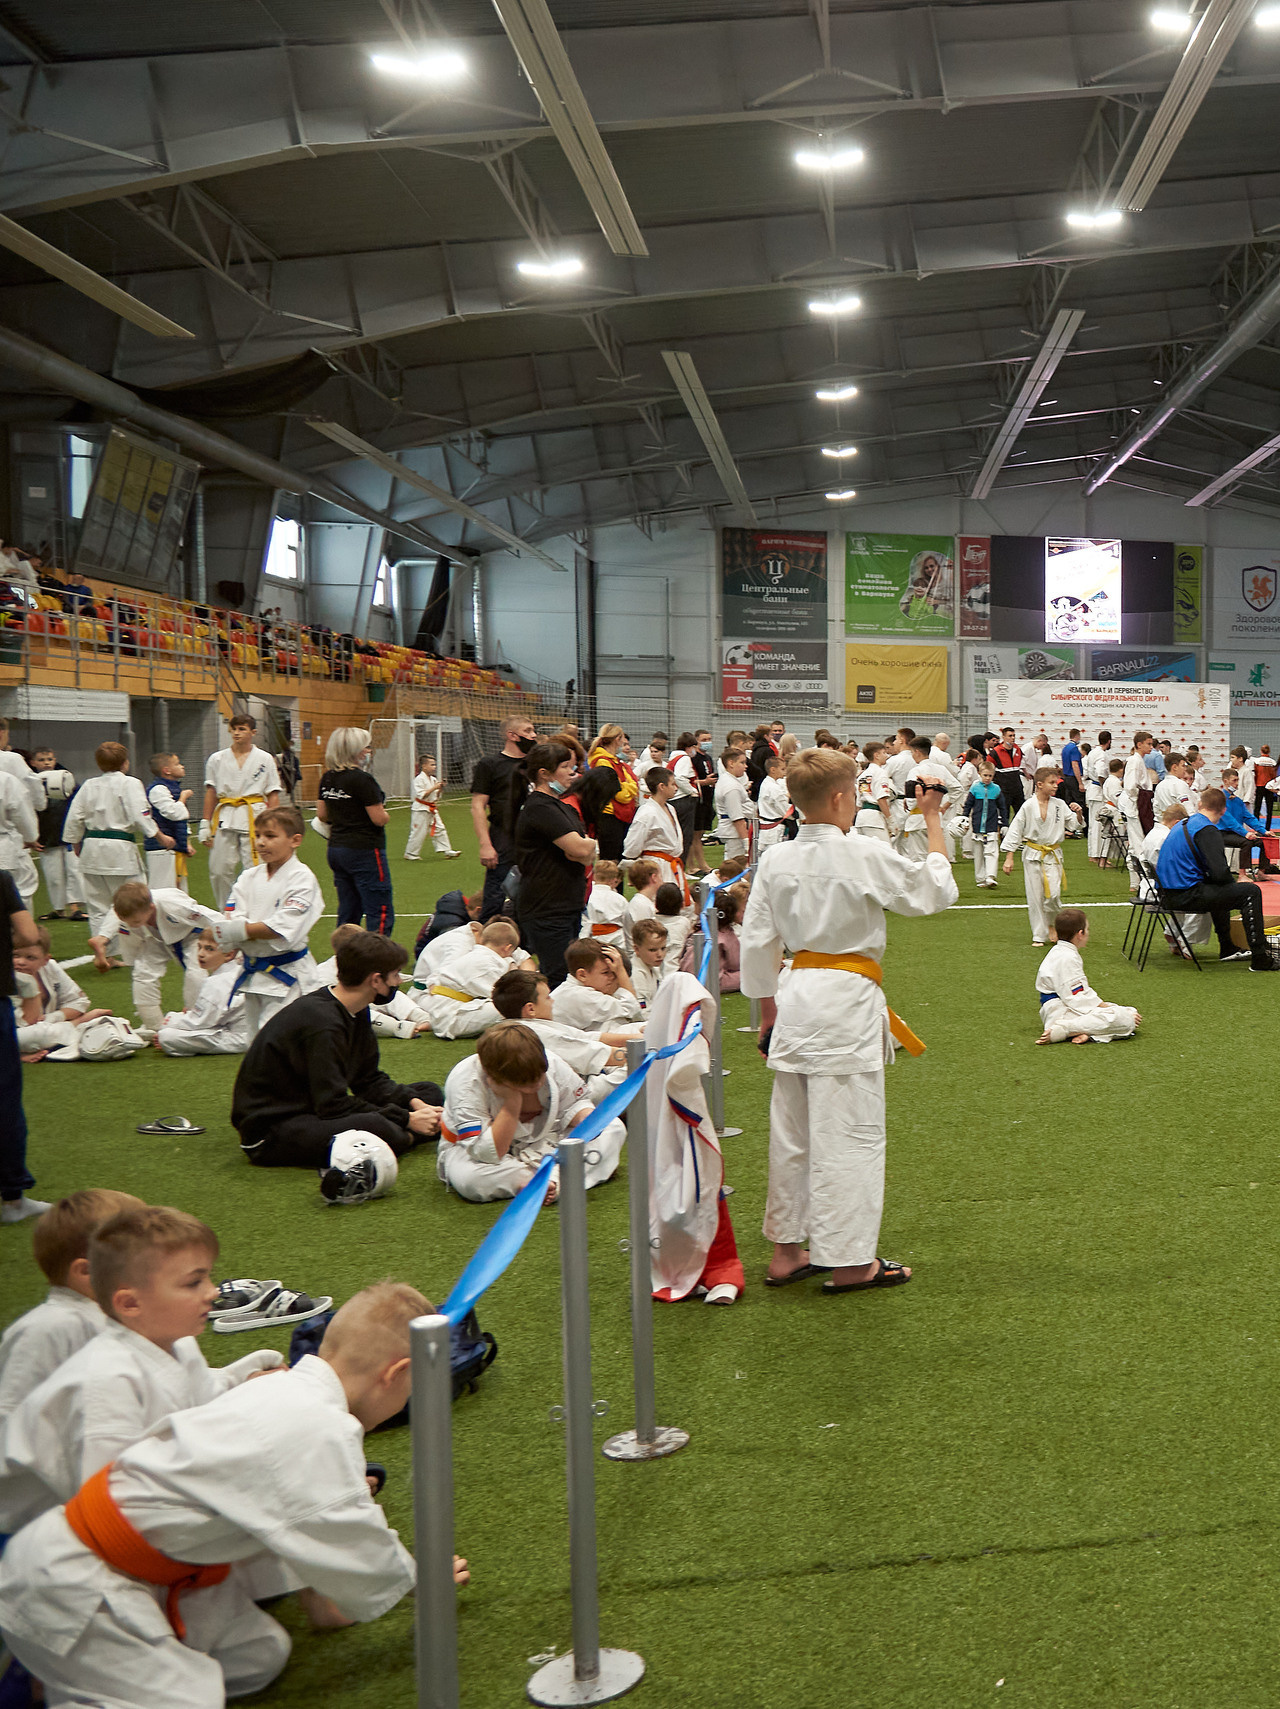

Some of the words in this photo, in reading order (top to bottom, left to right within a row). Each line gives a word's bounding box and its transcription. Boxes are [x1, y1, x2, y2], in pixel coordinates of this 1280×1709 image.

[741, 584, 809, 596] Центральные
[763, 594, 788, 603] бани
[754, 653, 796, 661] КОМАНДА
[754, 663, 780, 671] ИМЕЕТ
[851, 658, 879, 666] Очень
[880, 660, 920, 668] хорошие
[1114, 687, 1154, 695] ПЕРВЕНСТВО
[1094, 694, 1144, 702] ФЕДЕРАЛЬНОГО
